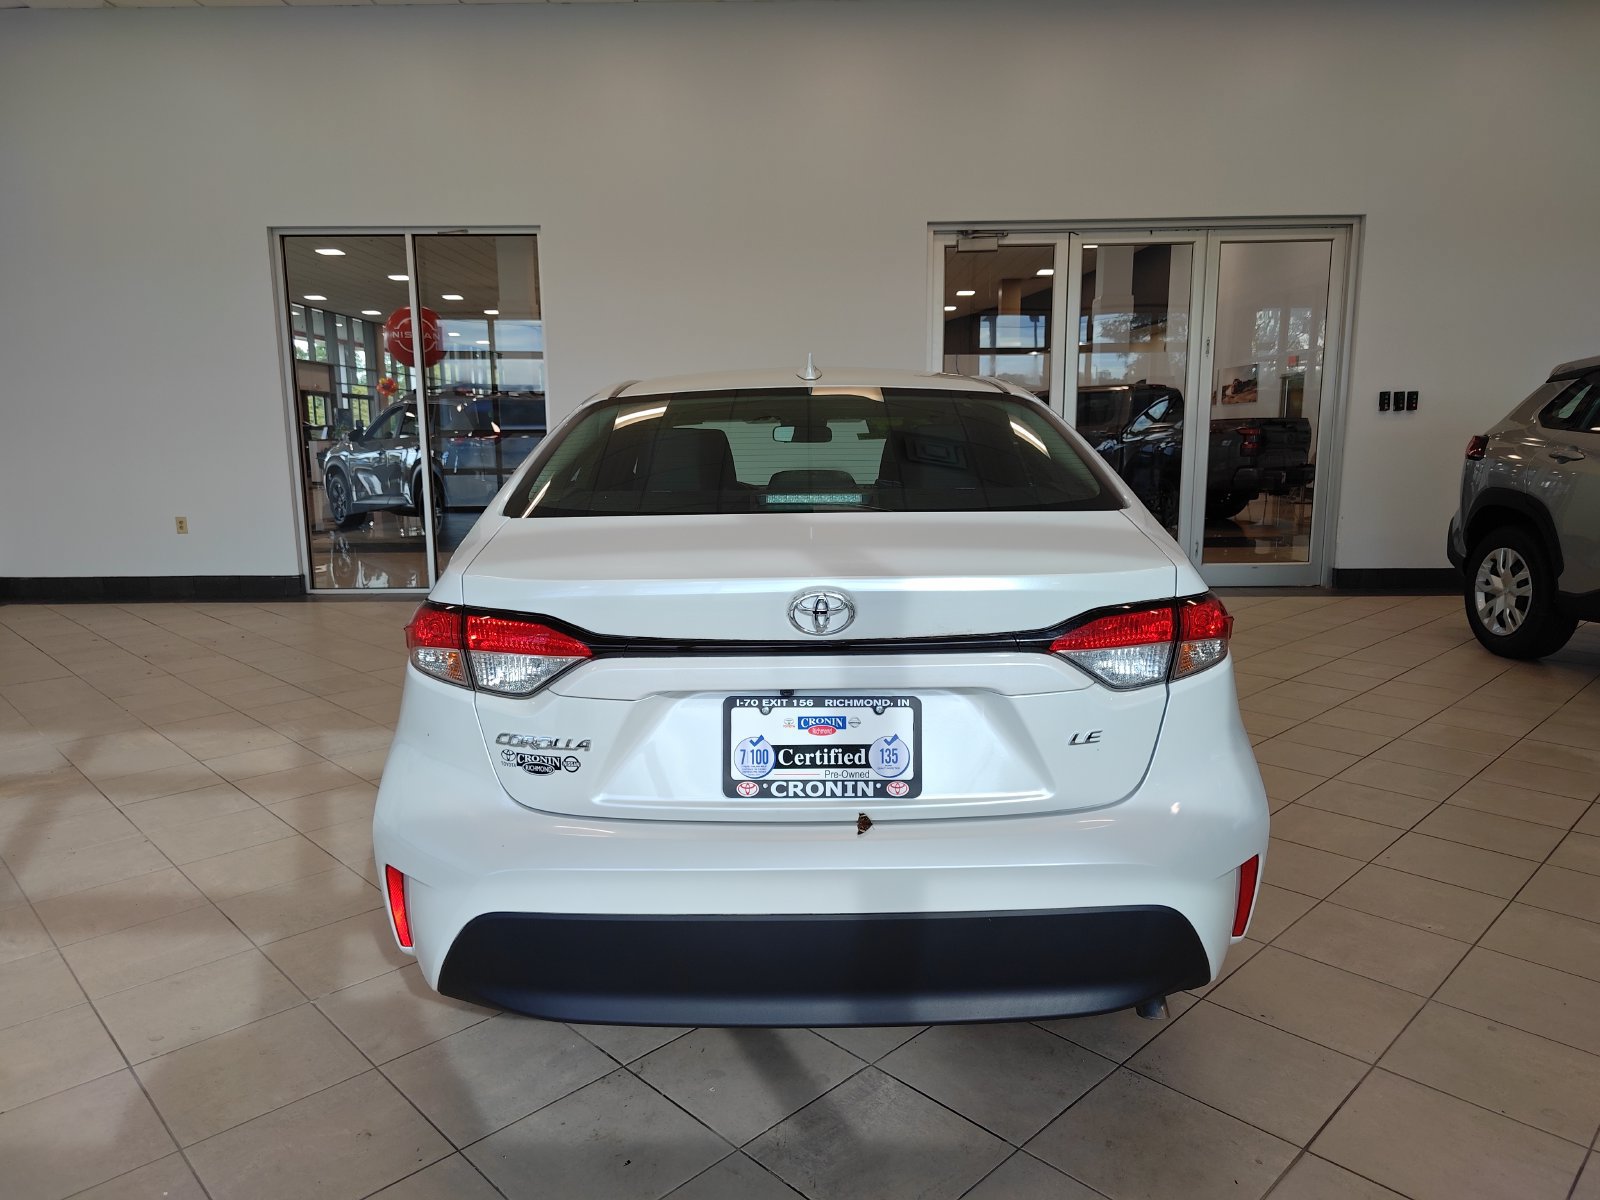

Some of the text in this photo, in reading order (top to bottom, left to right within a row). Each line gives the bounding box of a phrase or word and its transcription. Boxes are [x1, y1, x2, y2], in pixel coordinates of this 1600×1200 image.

[392, 331, 440, 339] NISAN
[736, 699, 910, 707] I-70 EXIT 156 RICHMOND, IN
[801, 717, 843, 728] CRONIN
[496, 732, 591, 751] COROLLA
[1068, 730, 1103, 745] LE
[517, 753, 561, 768] CRONIN
[778, 748, 866, 765] Certified
[880, 748, 898, 764] 135
[824, 770, 870, 779] Pre-Owned
[770, 781, 874, 797] CRONIN
